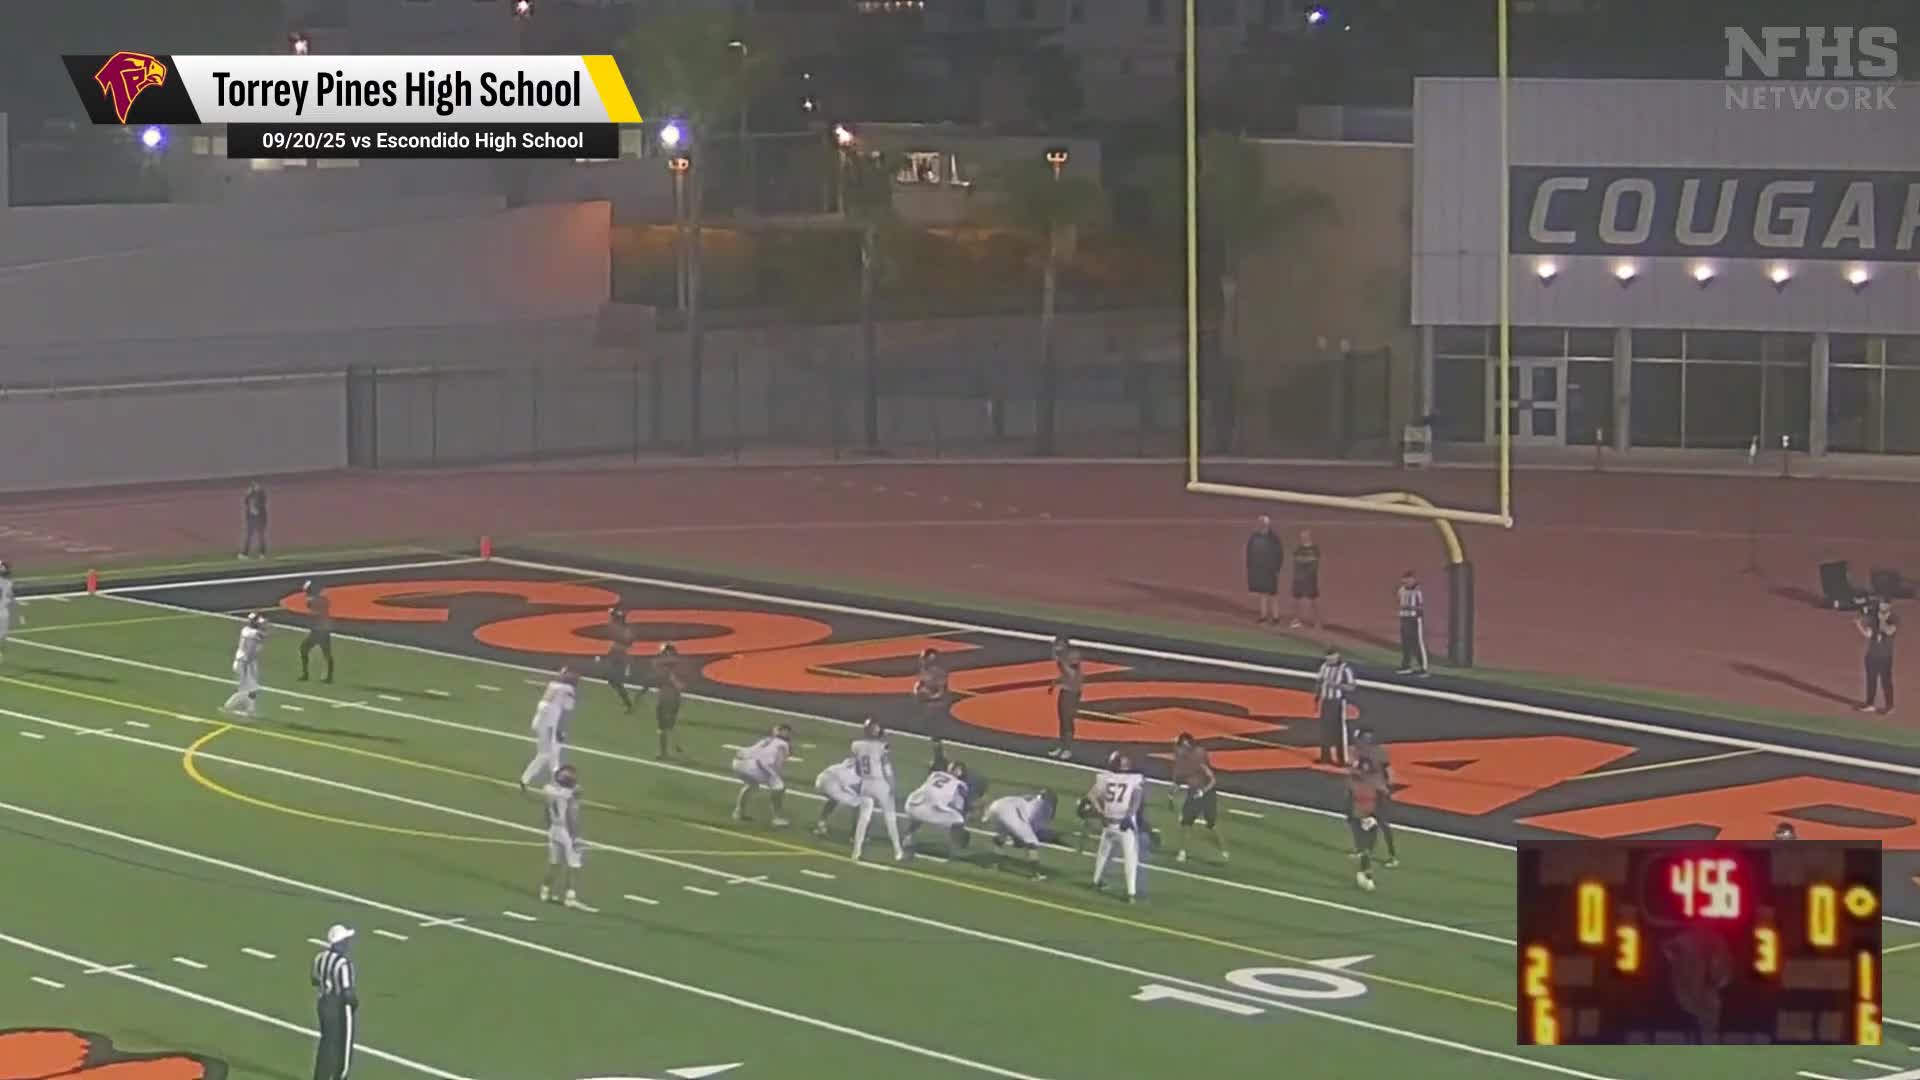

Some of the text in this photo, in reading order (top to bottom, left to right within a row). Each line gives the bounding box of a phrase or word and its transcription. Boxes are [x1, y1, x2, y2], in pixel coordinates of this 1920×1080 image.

[1105, 782, 1128, 803] 57
[1578, 883, 1605, 944] 0
[1809, 885, 1836, 946] 0
[1616, 927, 1639, 971] 3
[1754, 928, 1778, 973] 3
[1130, 966, 1367, 1015] 10
